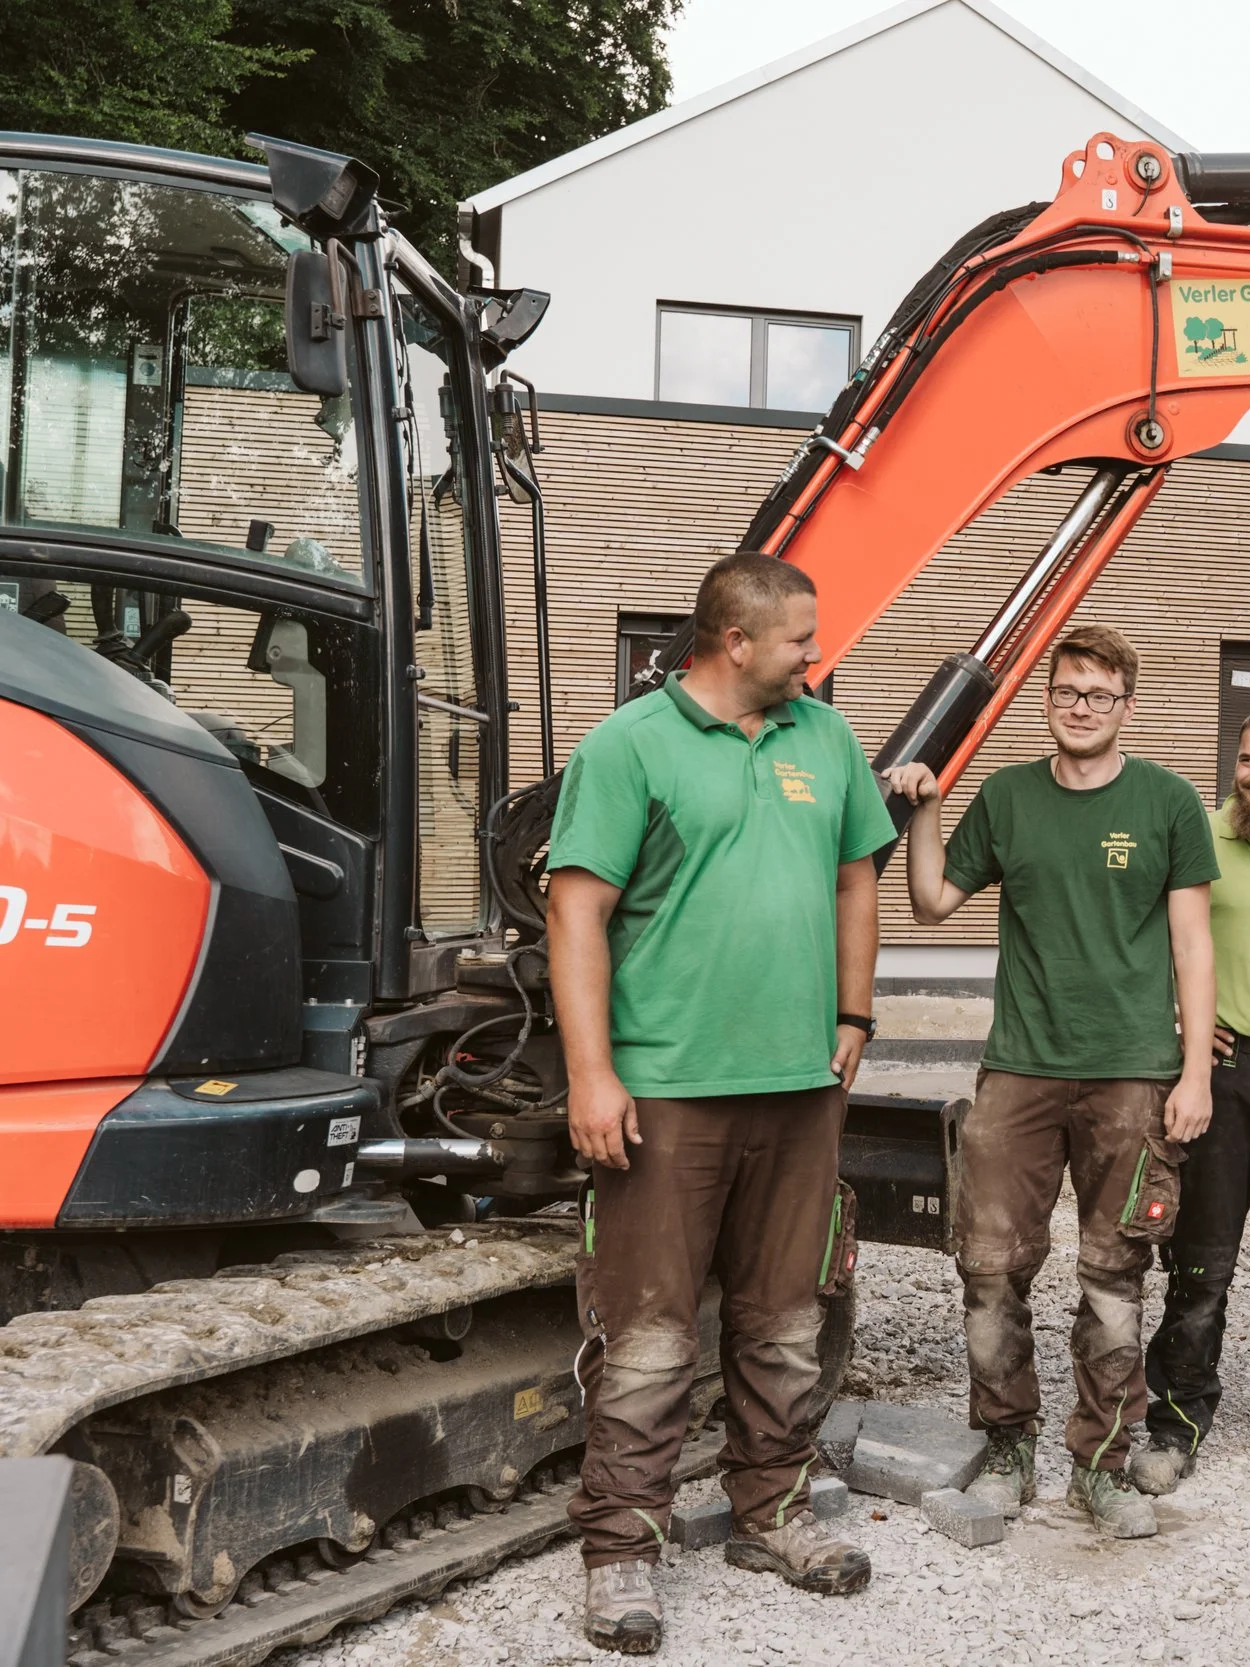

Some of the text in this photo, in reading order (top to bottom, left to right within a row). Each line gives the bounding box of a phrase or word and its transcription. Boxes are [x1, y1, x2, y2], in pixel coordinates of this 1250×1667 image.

[1179, 285, 1236, 303] Verler
[1101, 840, 1138, 848] Gartenbau
[329, 1131, 349, 1140] THEFT
